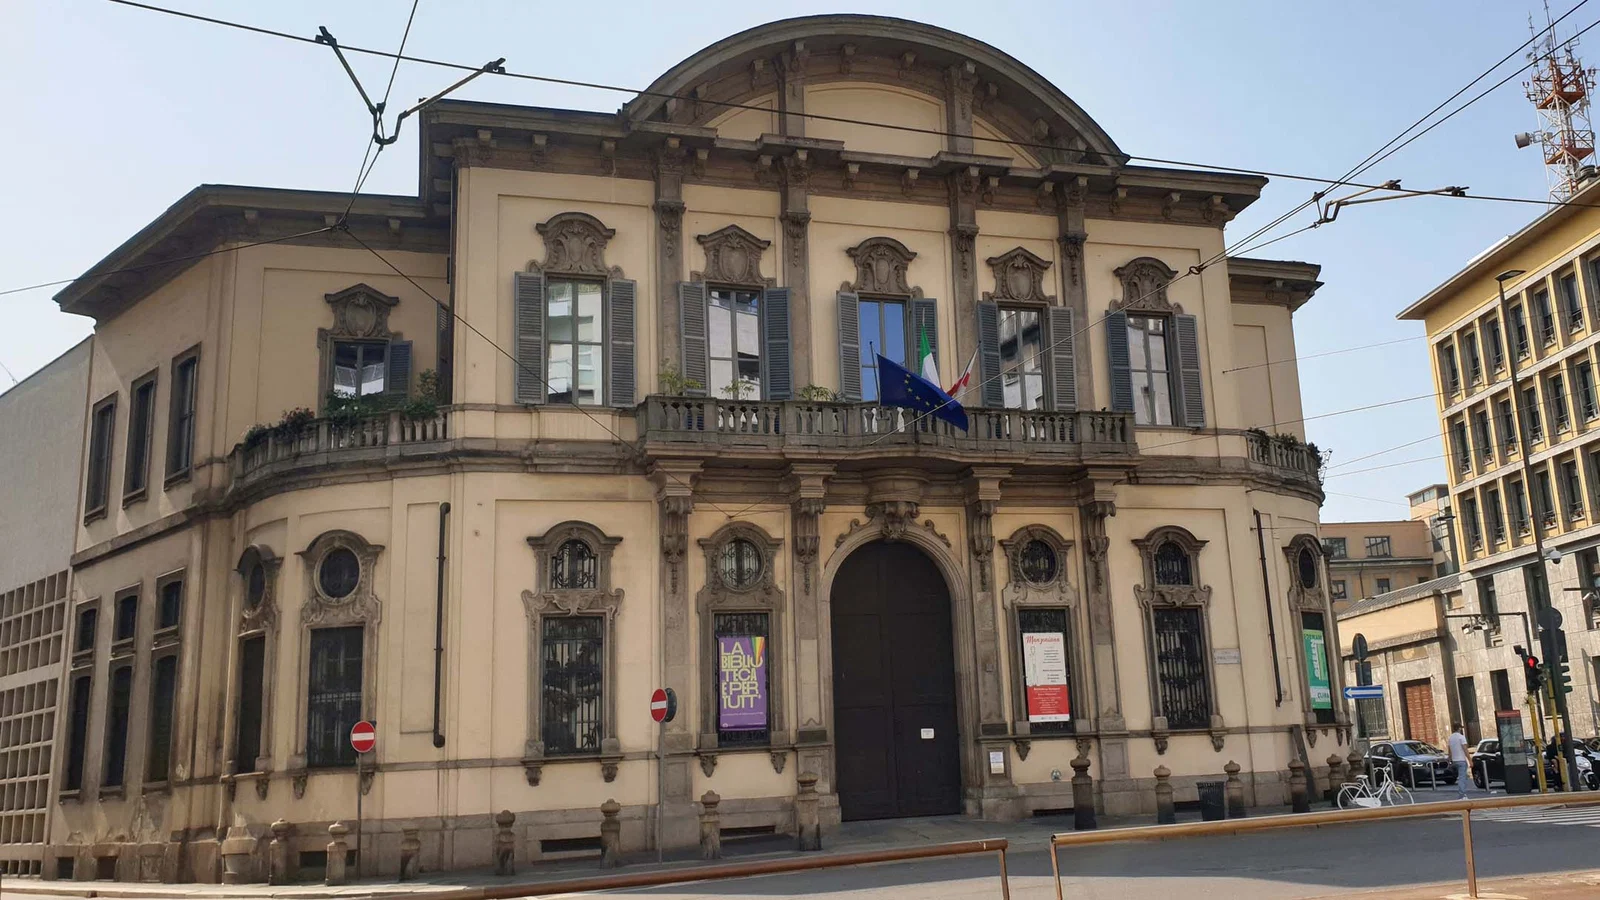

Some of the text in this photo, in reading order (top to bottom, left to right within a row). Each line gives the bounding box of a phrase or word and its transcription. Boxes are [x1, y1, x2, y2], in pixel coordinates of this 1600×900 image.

[721, 641, 744, 655] LA
[721, 667, 757, 682] TECA
[729, 681, 759, 695] PER
